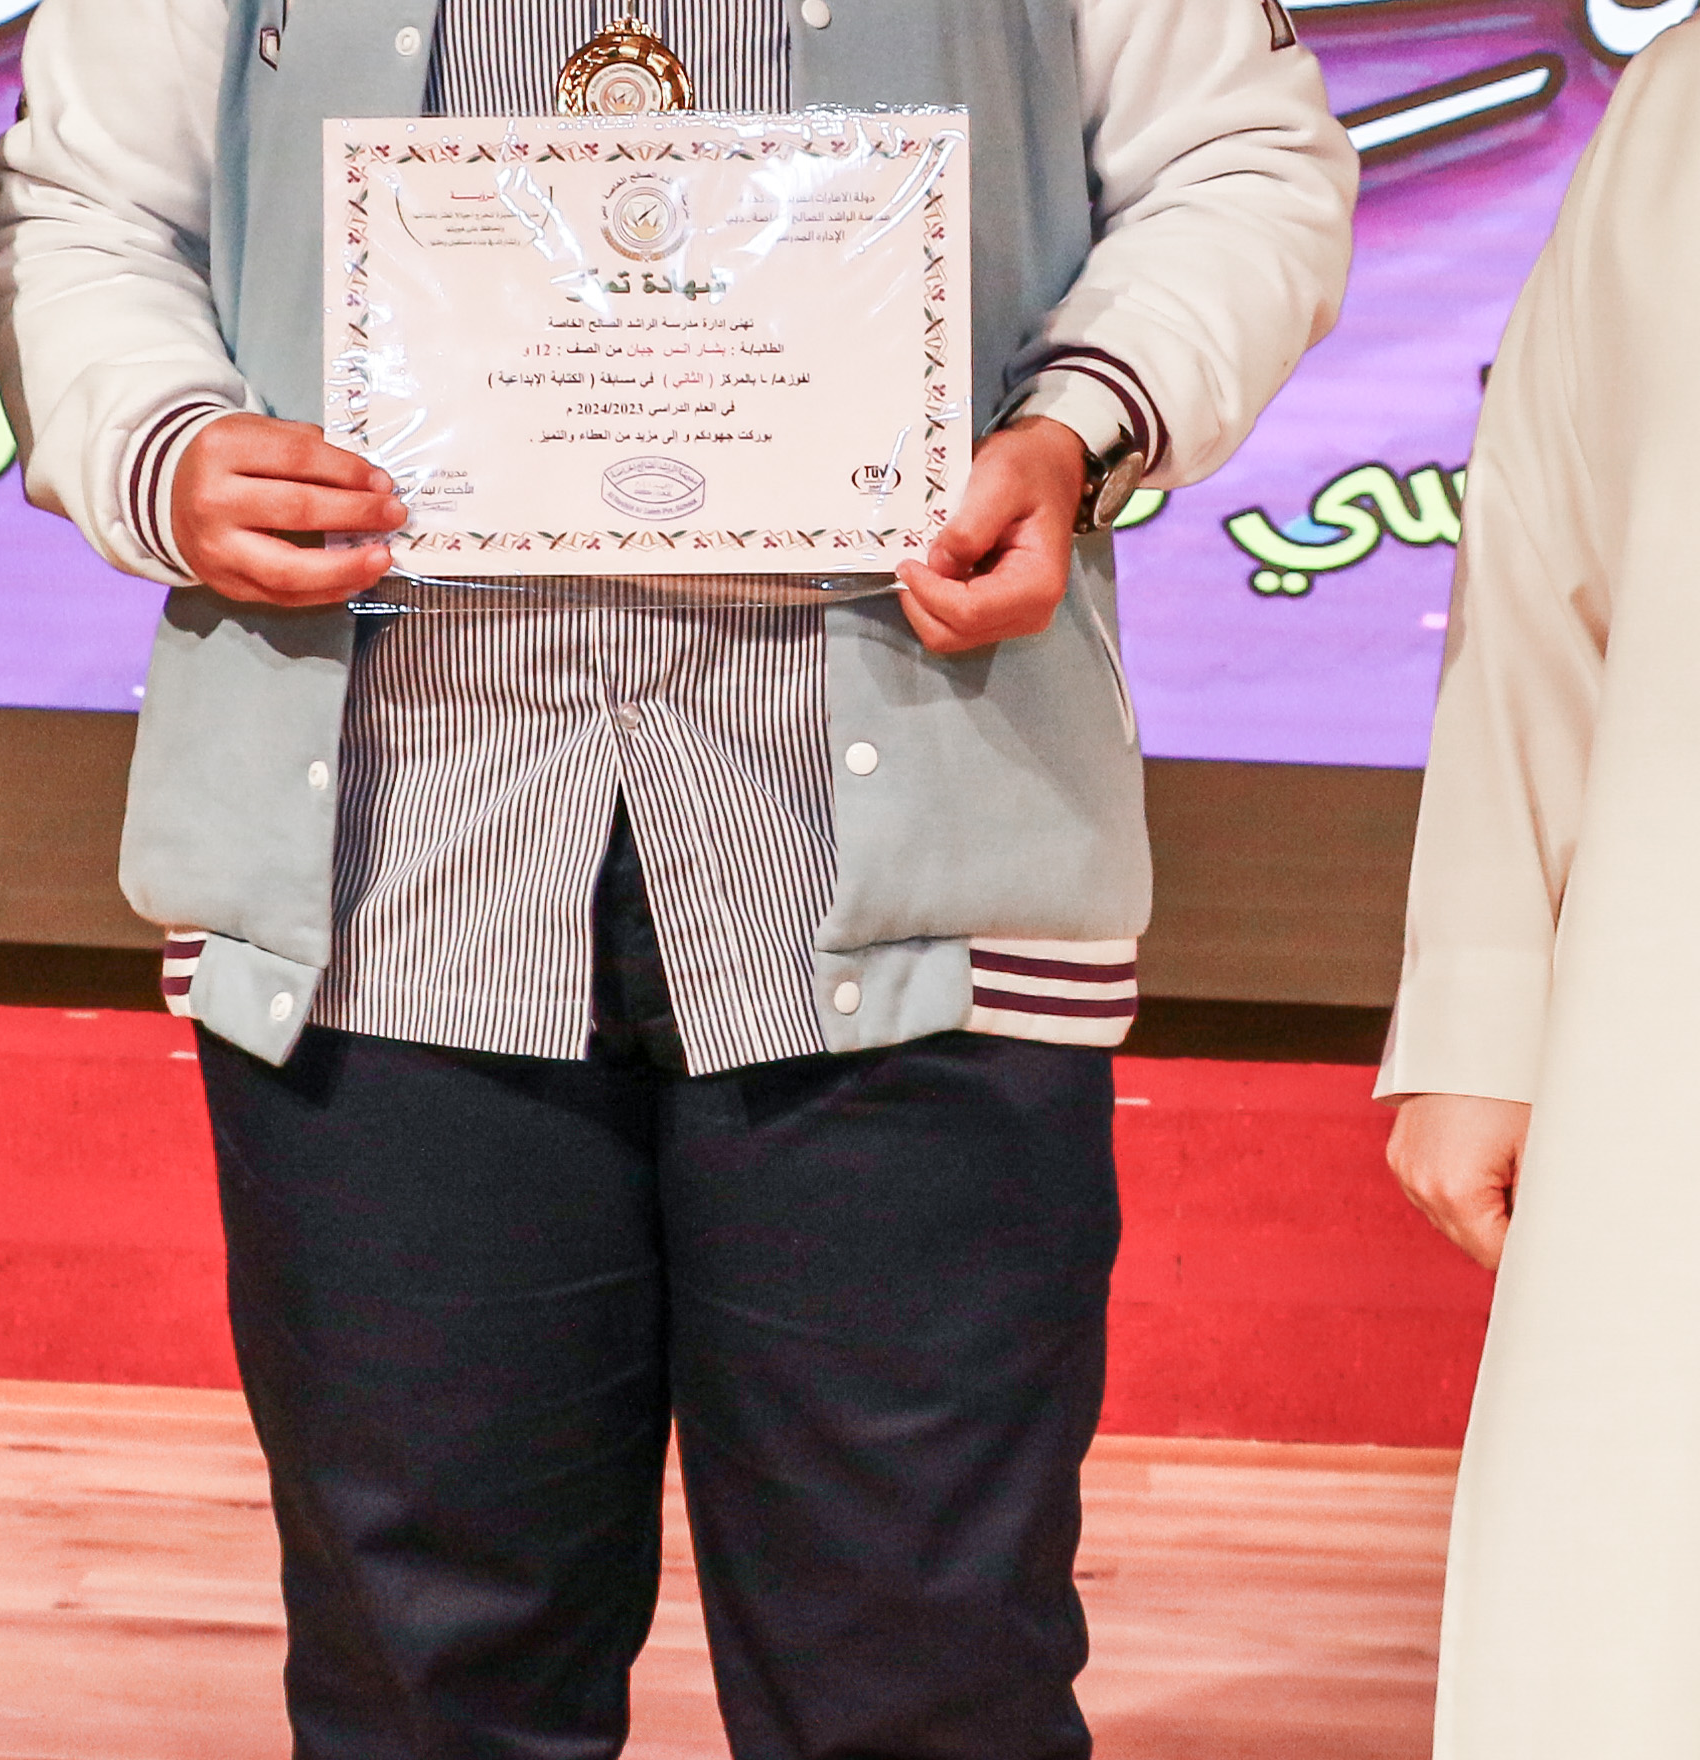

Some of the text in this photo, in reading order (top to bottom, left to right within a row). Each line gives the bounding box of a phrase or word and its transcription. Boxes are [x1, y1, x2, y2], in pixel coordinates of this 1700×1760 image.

[548, 316, 584, 328] الخاصة
[589, 318, 622, 332] الصالح
[627, 318, 658, 331] الراشد
[662, 316, 698, 330] مدرسة
[536, 344, 551, 356] 12
[566, 342, 601, 354] الصف
[605, 344, 623, 357] من
[600, 372, 636, 387] مسابقة
[640, 371, 654, 388] في
[719, 373, 757, 387] بالمركز
[695, 402, 717, 416] العام
[721, 400, 735, 416] في
[579, 429, 611, 441] العطاء
[614, 431, 631, 443] من
[635, 430, 658, 443] مزيد
[694, 430, 734, 443] جهودكم
[737, 430, 772, 443] بوركت
